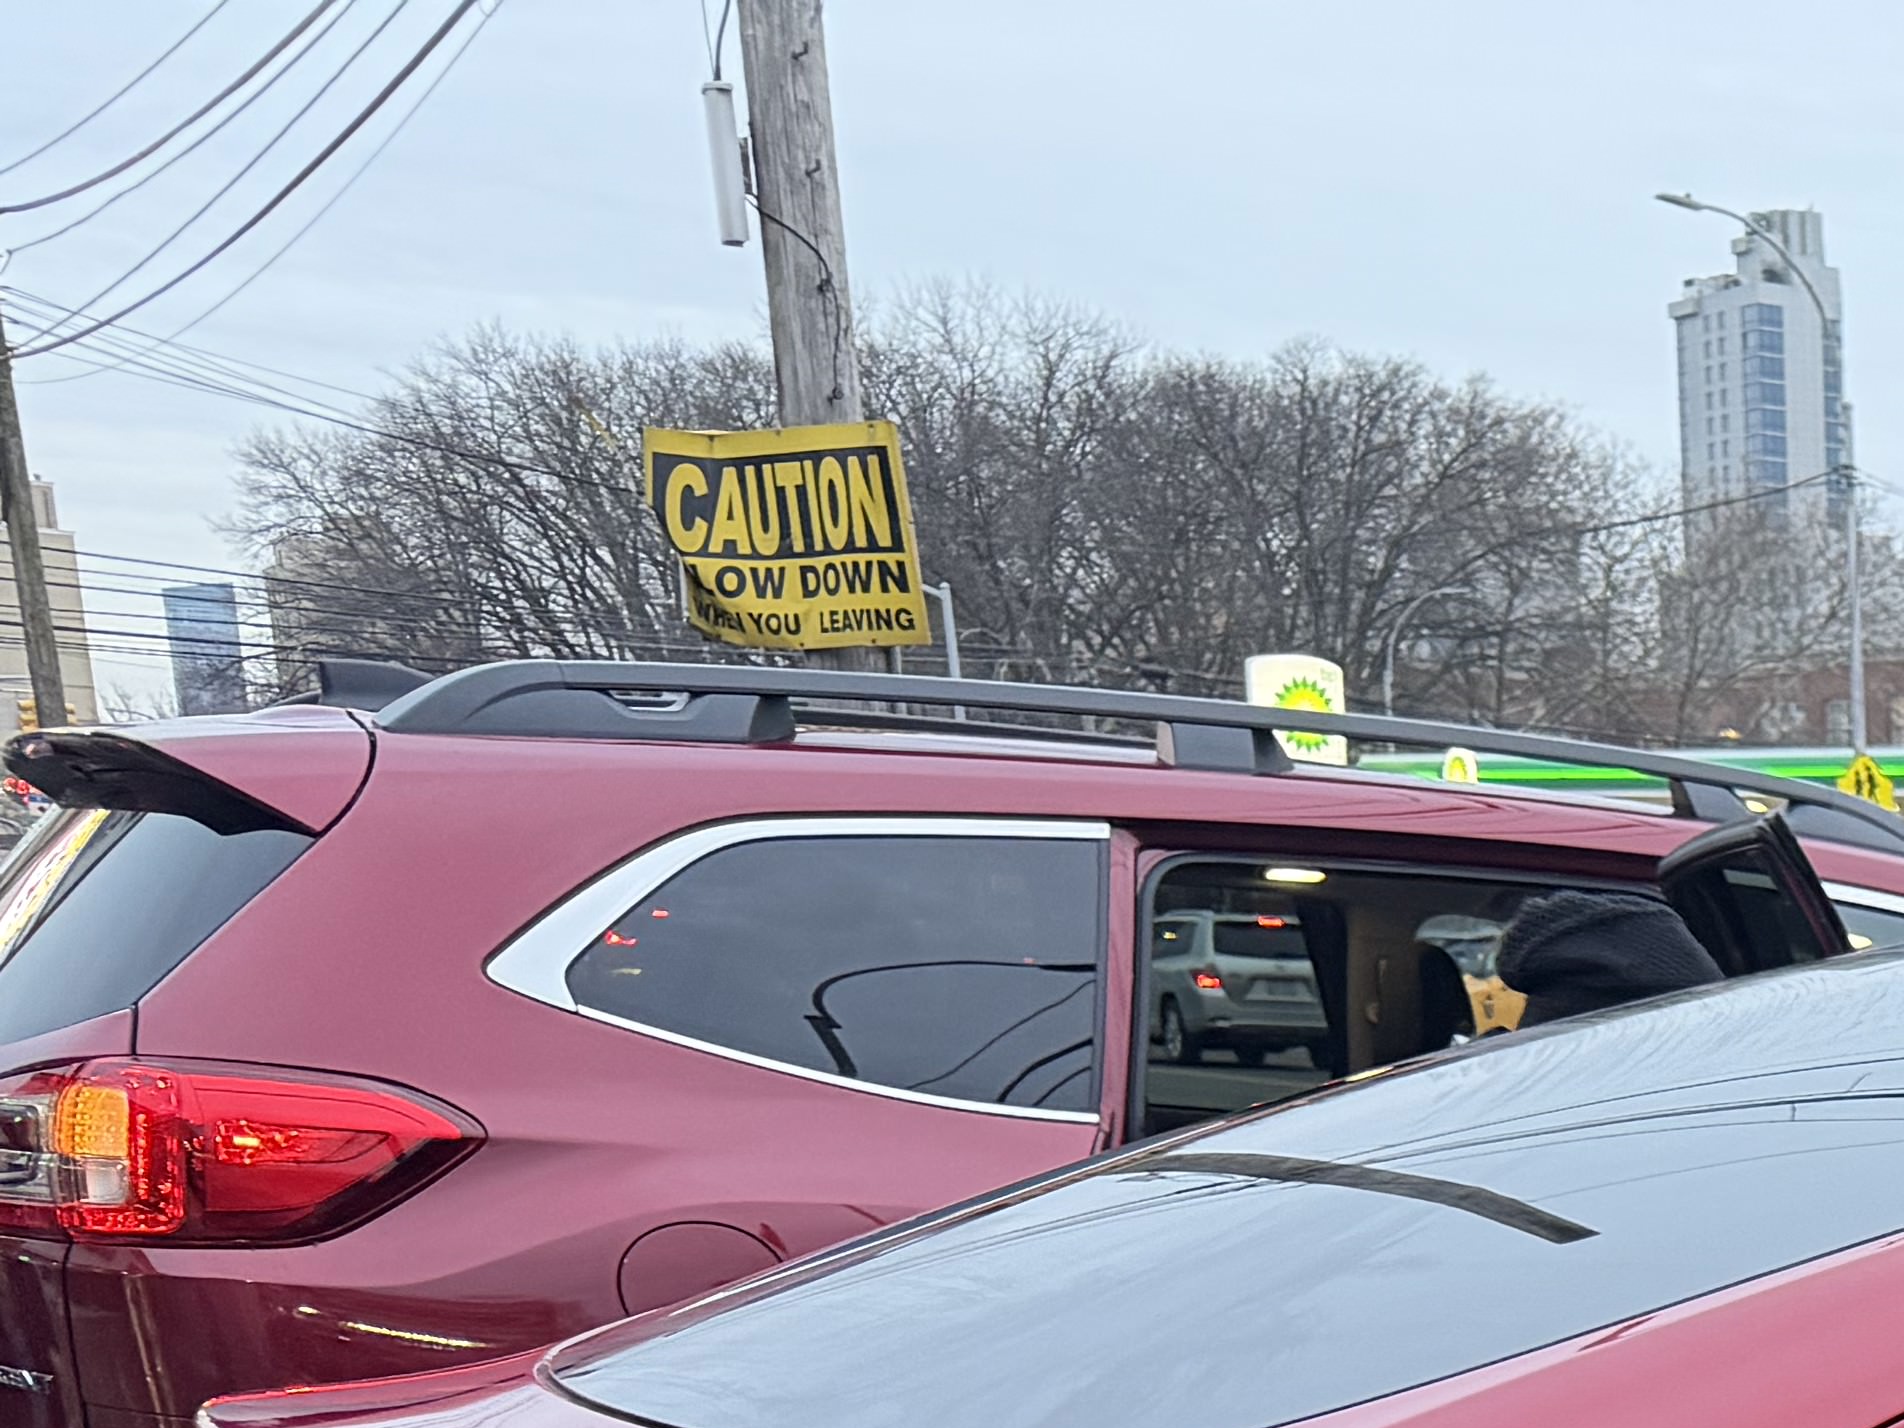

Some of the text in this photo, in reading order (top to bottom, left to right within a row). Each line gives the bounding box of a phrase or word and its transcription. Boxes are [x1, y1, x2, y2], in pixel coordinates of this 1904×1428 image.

[665, 455, 894, 556] CAUTION
[800, 560, 911, 599] DOWN
[747, 610, 801, 636] YOU
[819, 607, 916, 634] LEAVING
